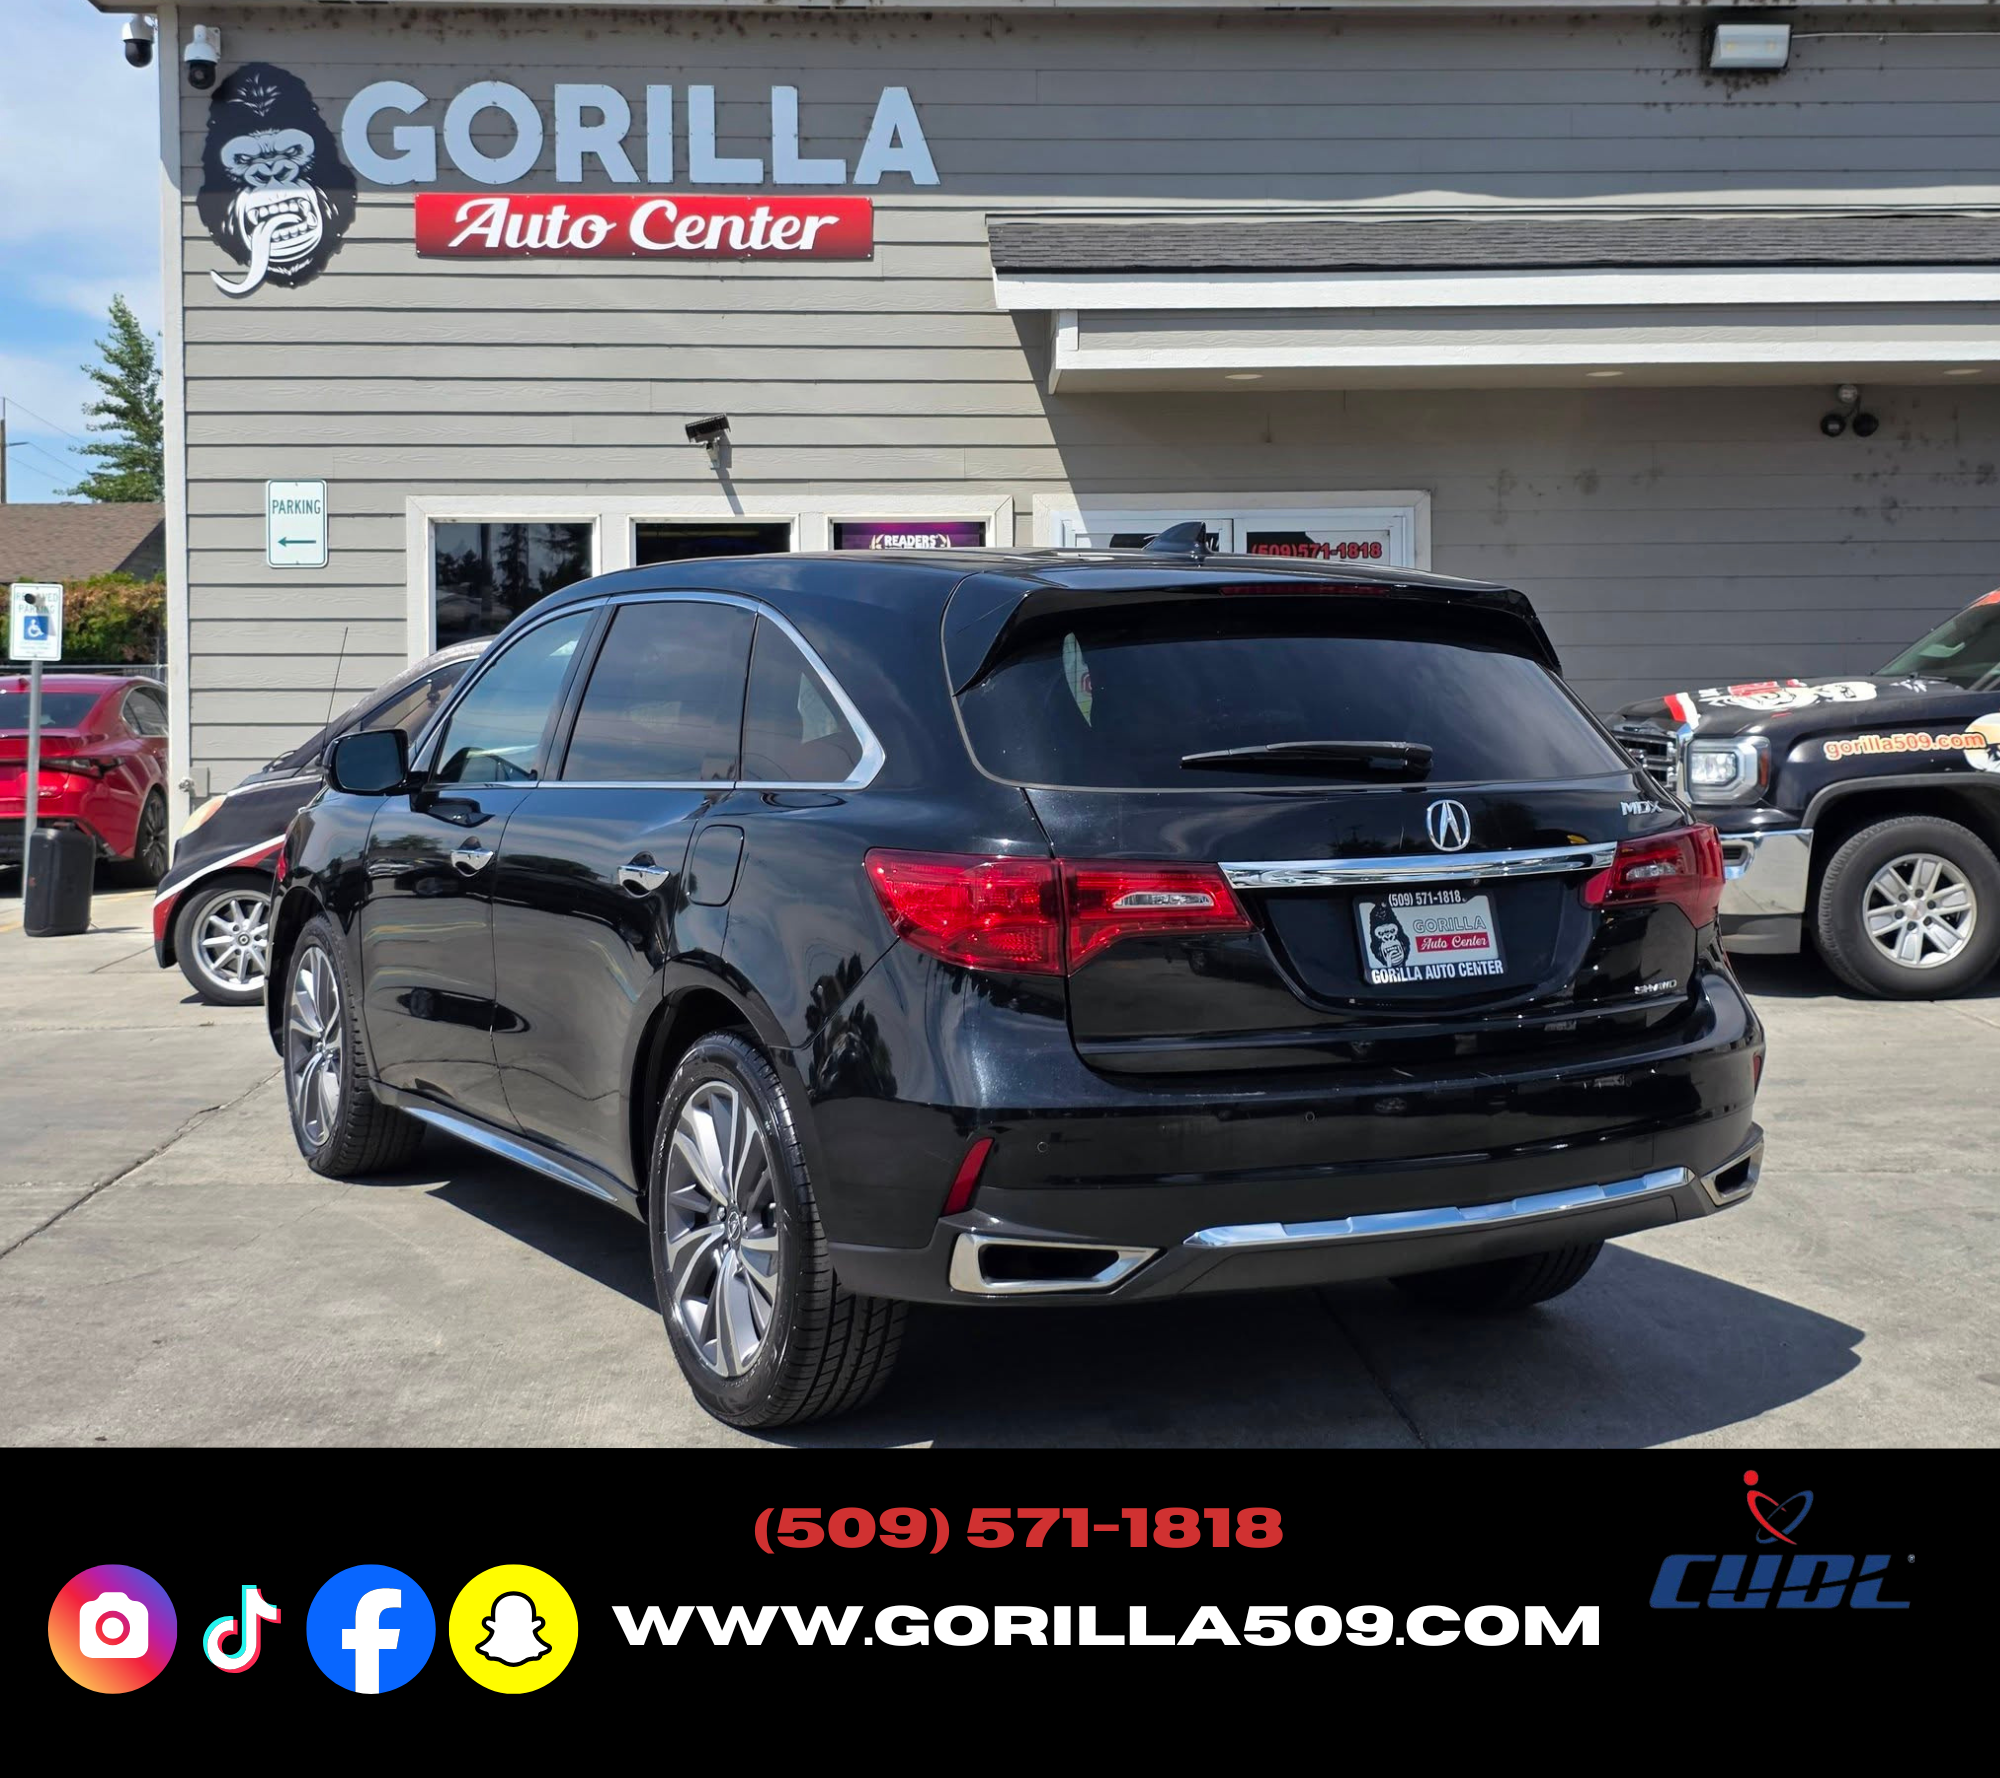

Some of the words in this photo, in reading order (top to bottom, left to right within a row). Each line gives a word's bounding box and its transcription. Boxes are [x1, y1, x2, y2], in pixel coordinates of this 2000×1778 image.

[341, 80, 941, 186] GORILLA
[448, 197, 617, 249] Auto
[629, 198, 839, 251] Center
[272, 499, 321, 515] PARKING
[1824, 732, 1987, 761] gorilla509.com
[1620, 800, 1663, 816] MDX
[1388, 893, 1413, 907] (509)
[1415, 889, 1461, 905] 571-1818
[1412, 915, 1487, 934] GORILLA
[1421, 937, 1448, 950] Auto
[1451, 935, 1488, 949] Center
[1371, 967, 1423, 985] GORILLA
[1425, 963, 1456, 980] AUTO
[1458, 960, 1504, 978] CENTER
